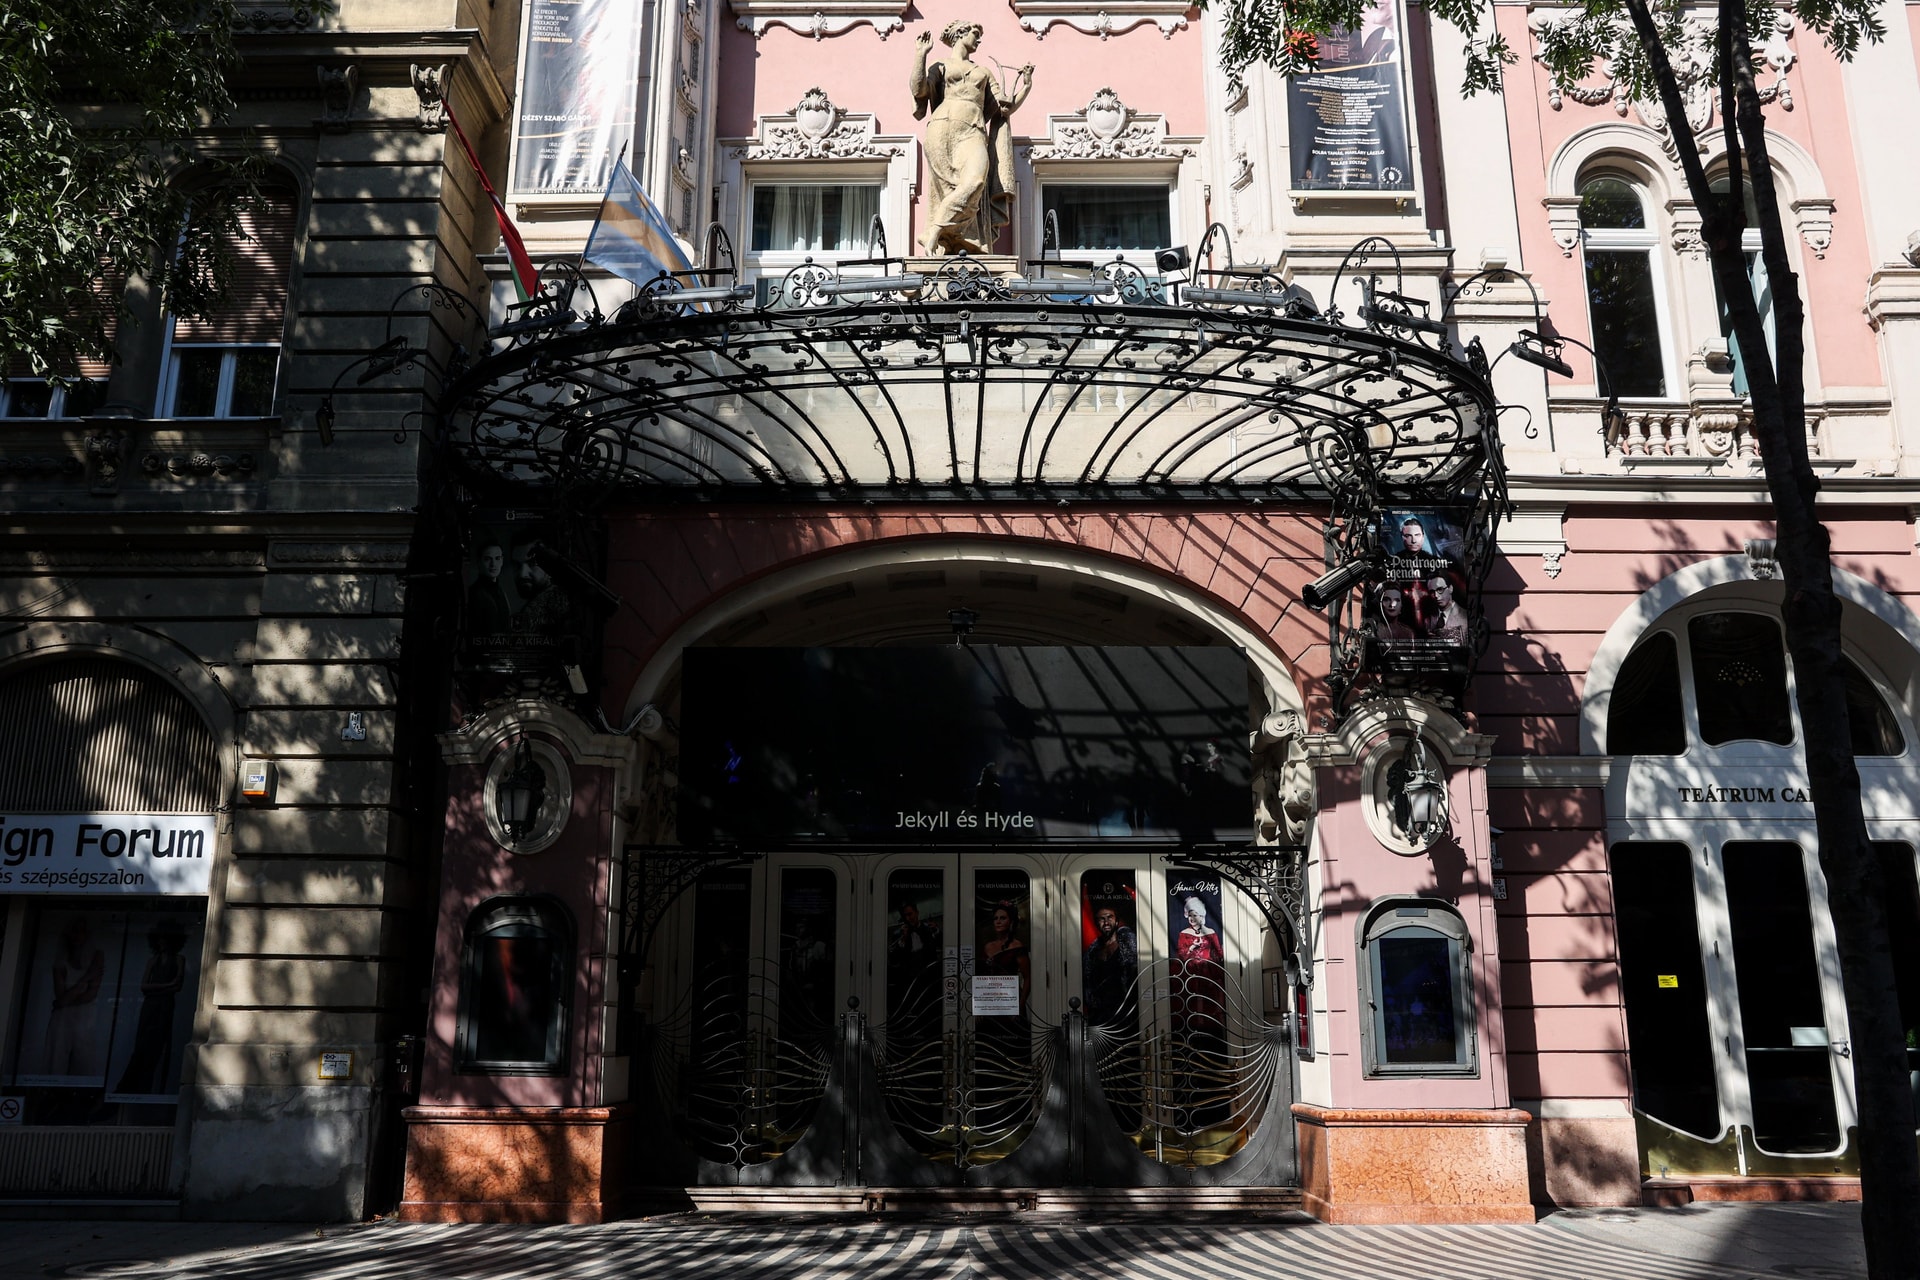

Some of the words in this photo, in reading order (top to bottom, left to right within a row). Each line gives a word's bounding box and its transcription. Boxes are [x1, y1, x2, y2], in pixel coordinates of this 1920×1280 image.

[1386, 567, 1421, 582] egenda
[1678, 784, 1776, 803] TEÁTRUM
[895, 811, 949, 832] Jekyll
[956, 810, 978, 828] és
[985, 811, 1034, 832] Hyde
[75, 823, 205, 858] Forum
[20, 867, 144, 888] szépségszalon
